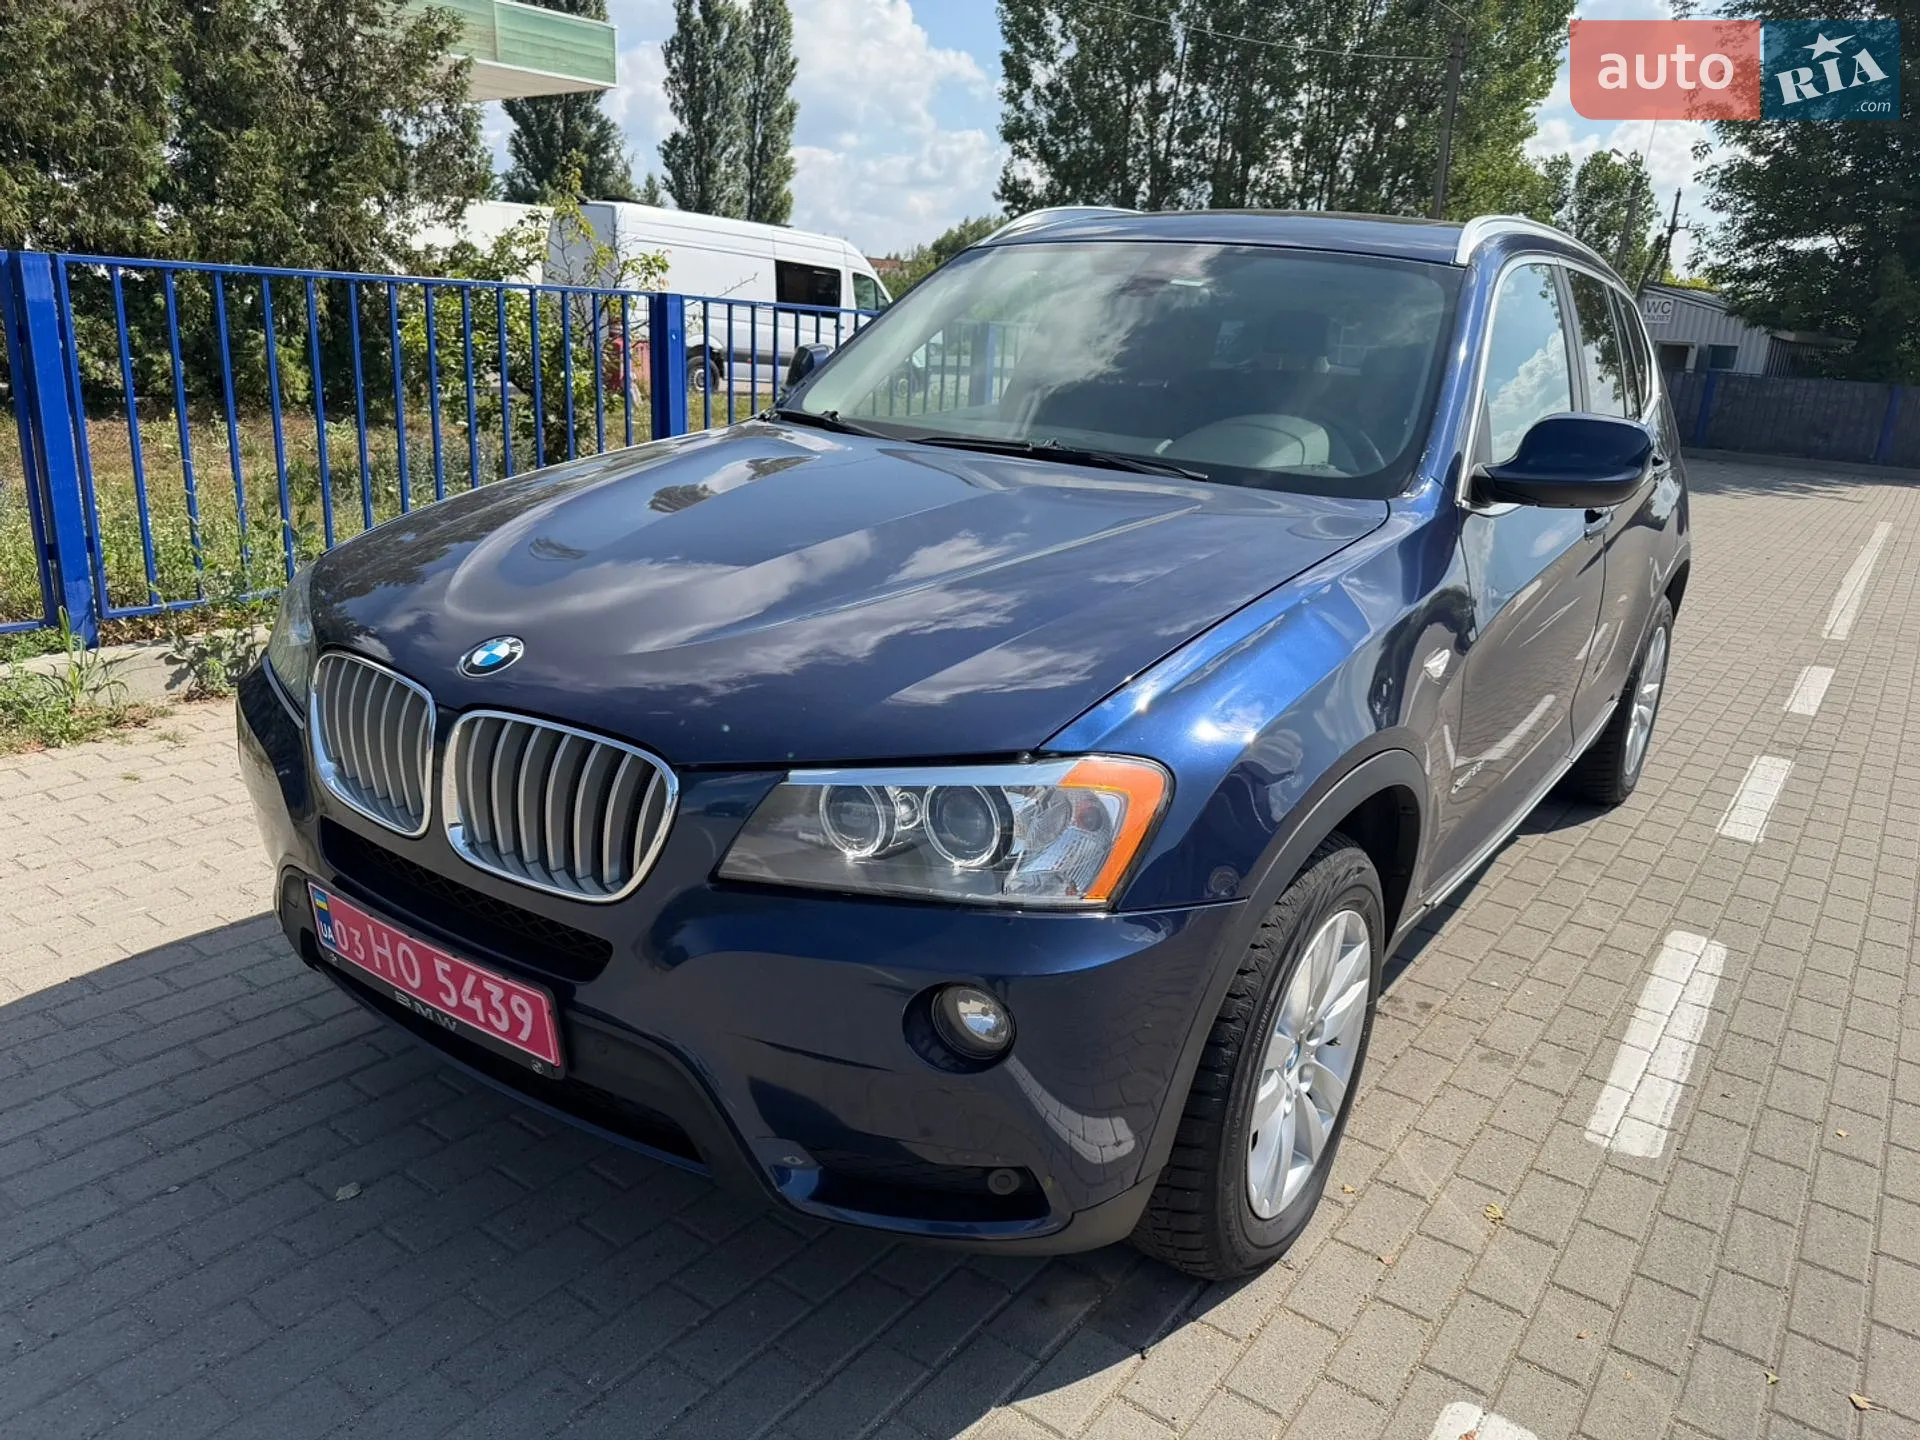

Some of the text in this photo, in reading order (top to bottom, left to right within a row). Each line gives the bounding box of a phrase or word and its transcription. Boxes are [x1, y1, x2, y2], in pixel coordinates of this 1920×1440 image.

[1646, 300, 1672, 314] WC
[320, 921, 336, 944] UA
[335, 919, 534, 1042] 03 HO 5439
[393, 990, 457, 1031] BMW
